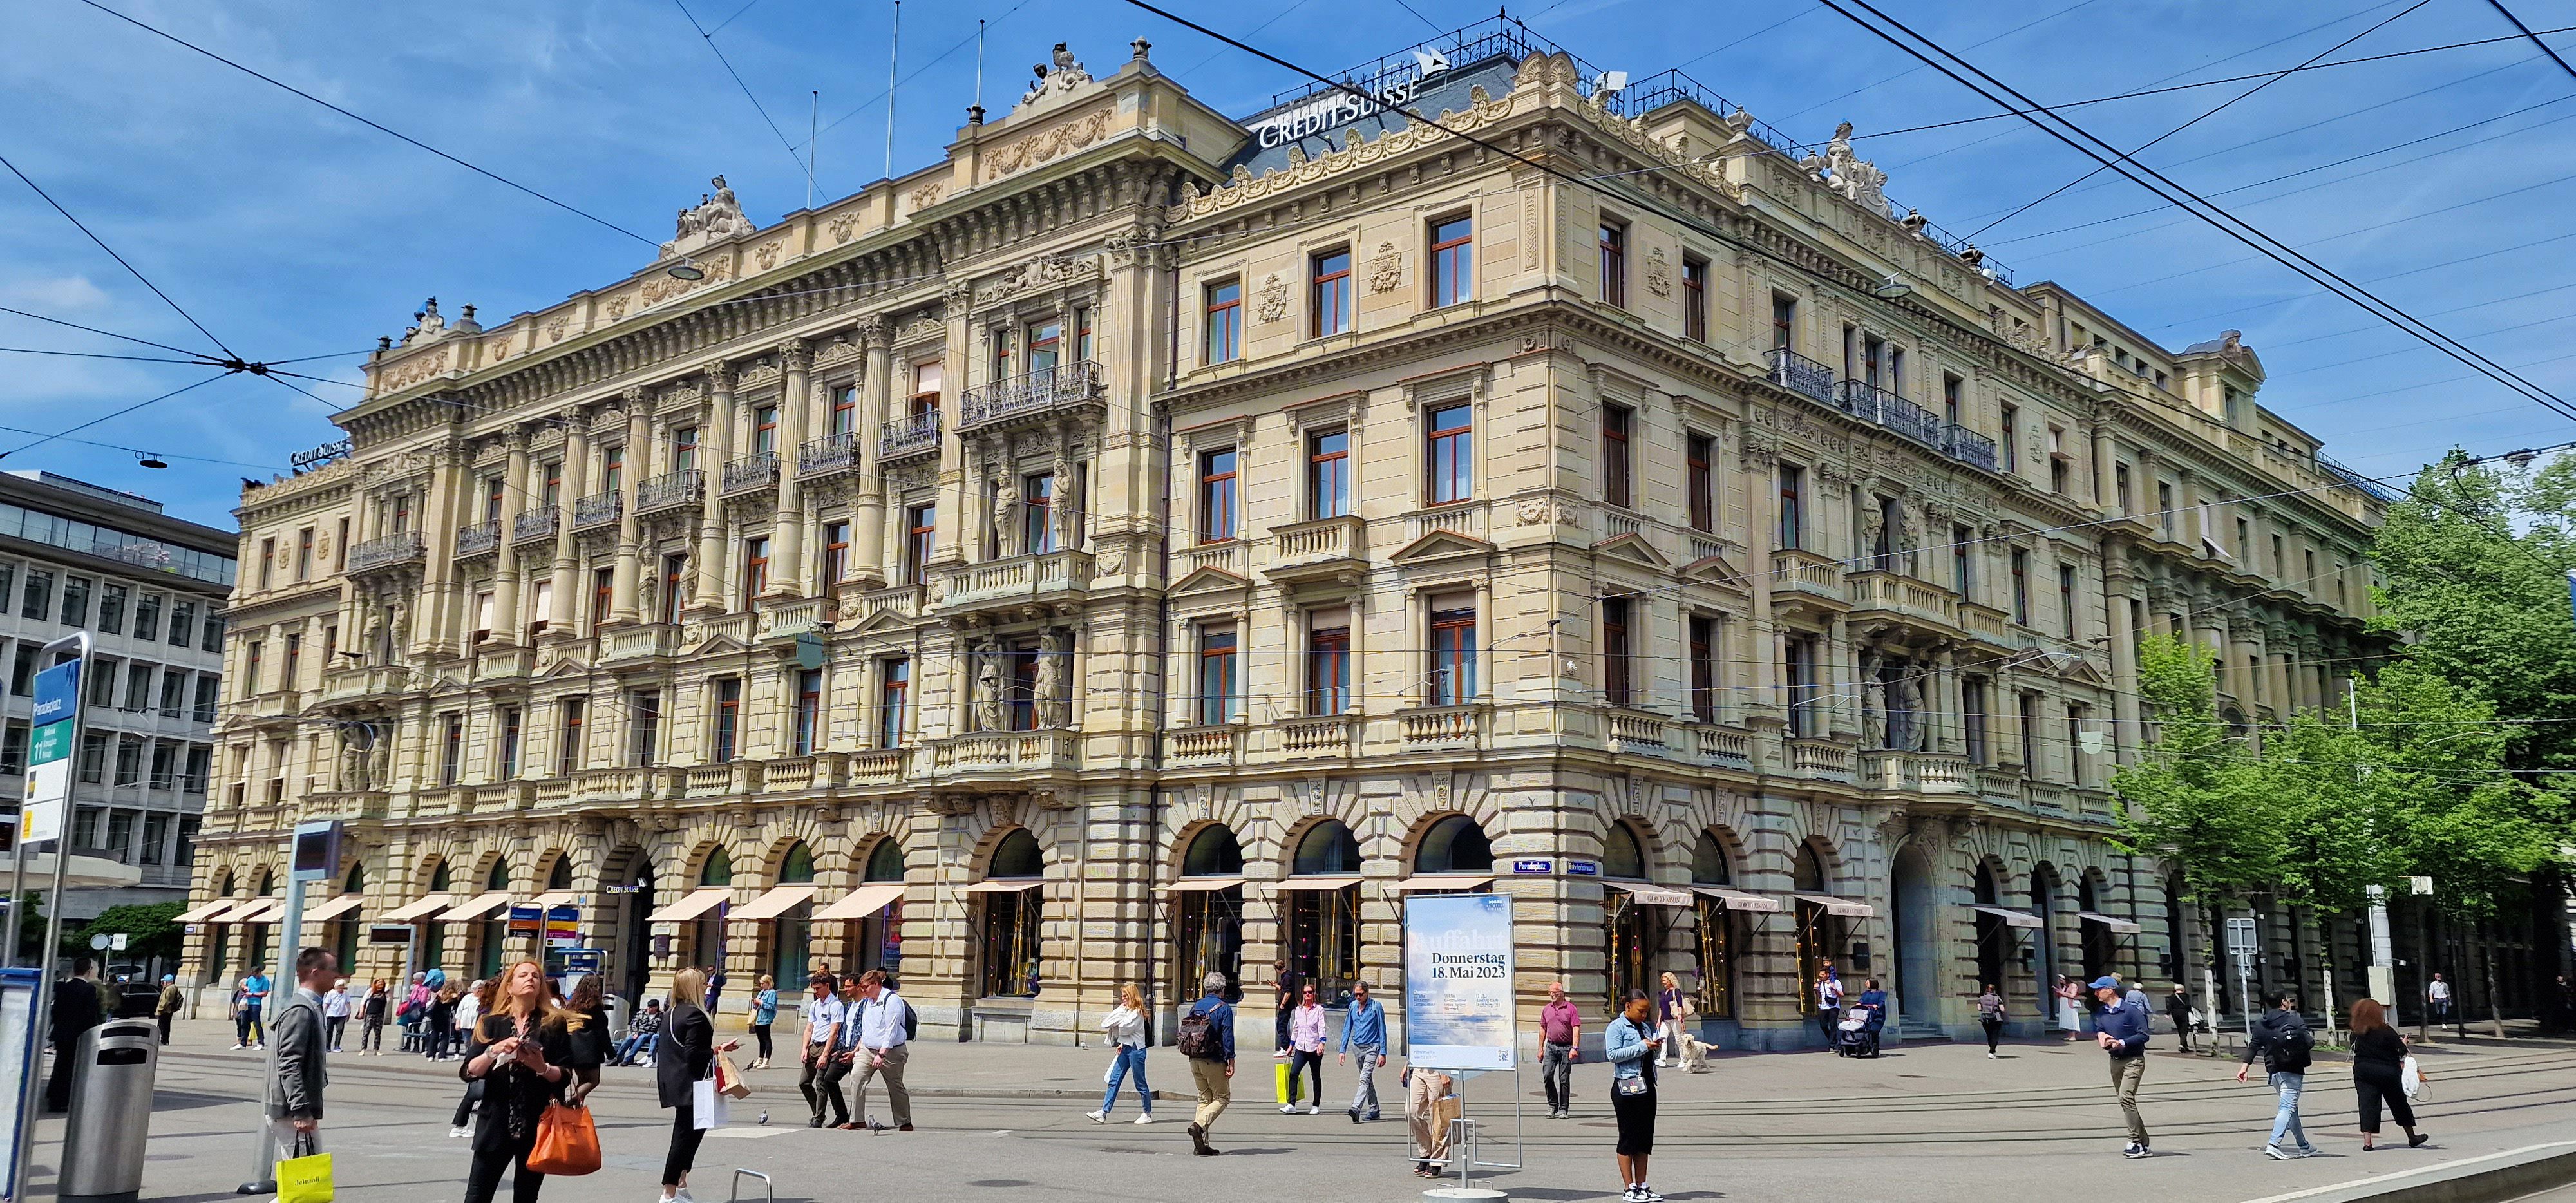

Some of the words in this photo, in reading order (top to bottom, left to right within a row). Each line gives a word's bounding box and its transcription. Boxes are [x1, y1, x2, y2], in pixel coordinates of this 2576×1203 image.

[1259, 104, 1339, 149] CREDIT
[1344, 77, 1421, 121] SUISSE
[289, 447, 318, 465] CREDIT
[318, 439, 346, 457] SUISSE
[34, 741, 43, 761] 11
[1432, 952, 1506, 969] Donnerstag
[1432, 967, 1448, 978] 18.
[1450, 966, 1473, 978] Mai
[1477, 967, 1506, 978] 2023
